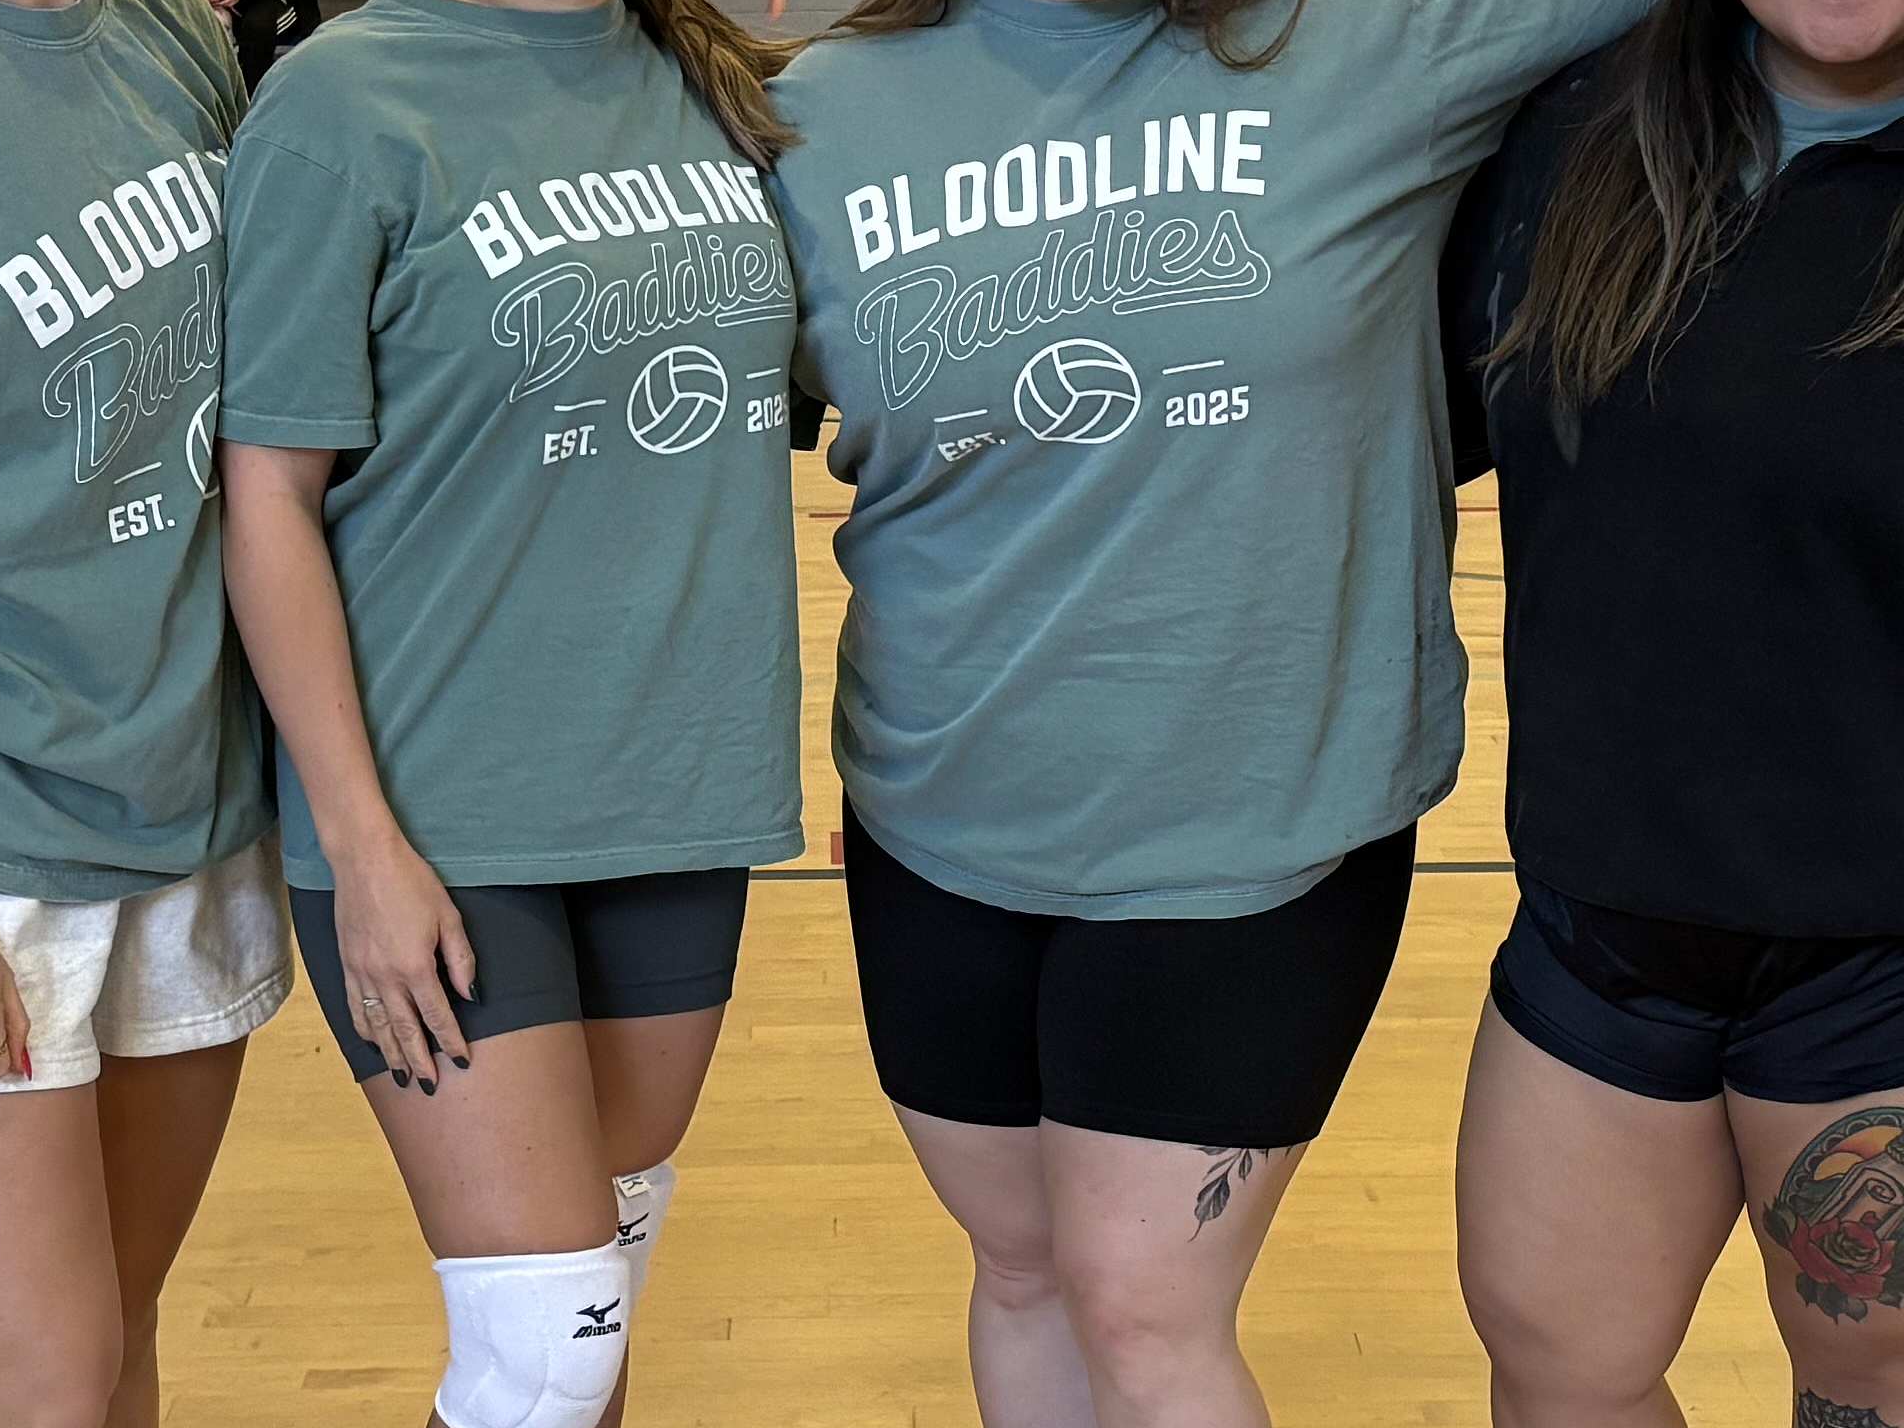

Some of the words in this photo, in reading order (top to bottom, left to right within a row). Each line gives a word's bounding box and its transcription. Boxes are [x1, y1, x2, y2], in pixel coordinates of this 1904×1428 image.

[845, 109, 1271, 273] BLOODLINE
[855, 209, 1271, 411] Baddies
[1164, 385, 1251, 428] 2025
[542, 425, 598, 465] EST.
[107, 493, 176, 544] EST.
